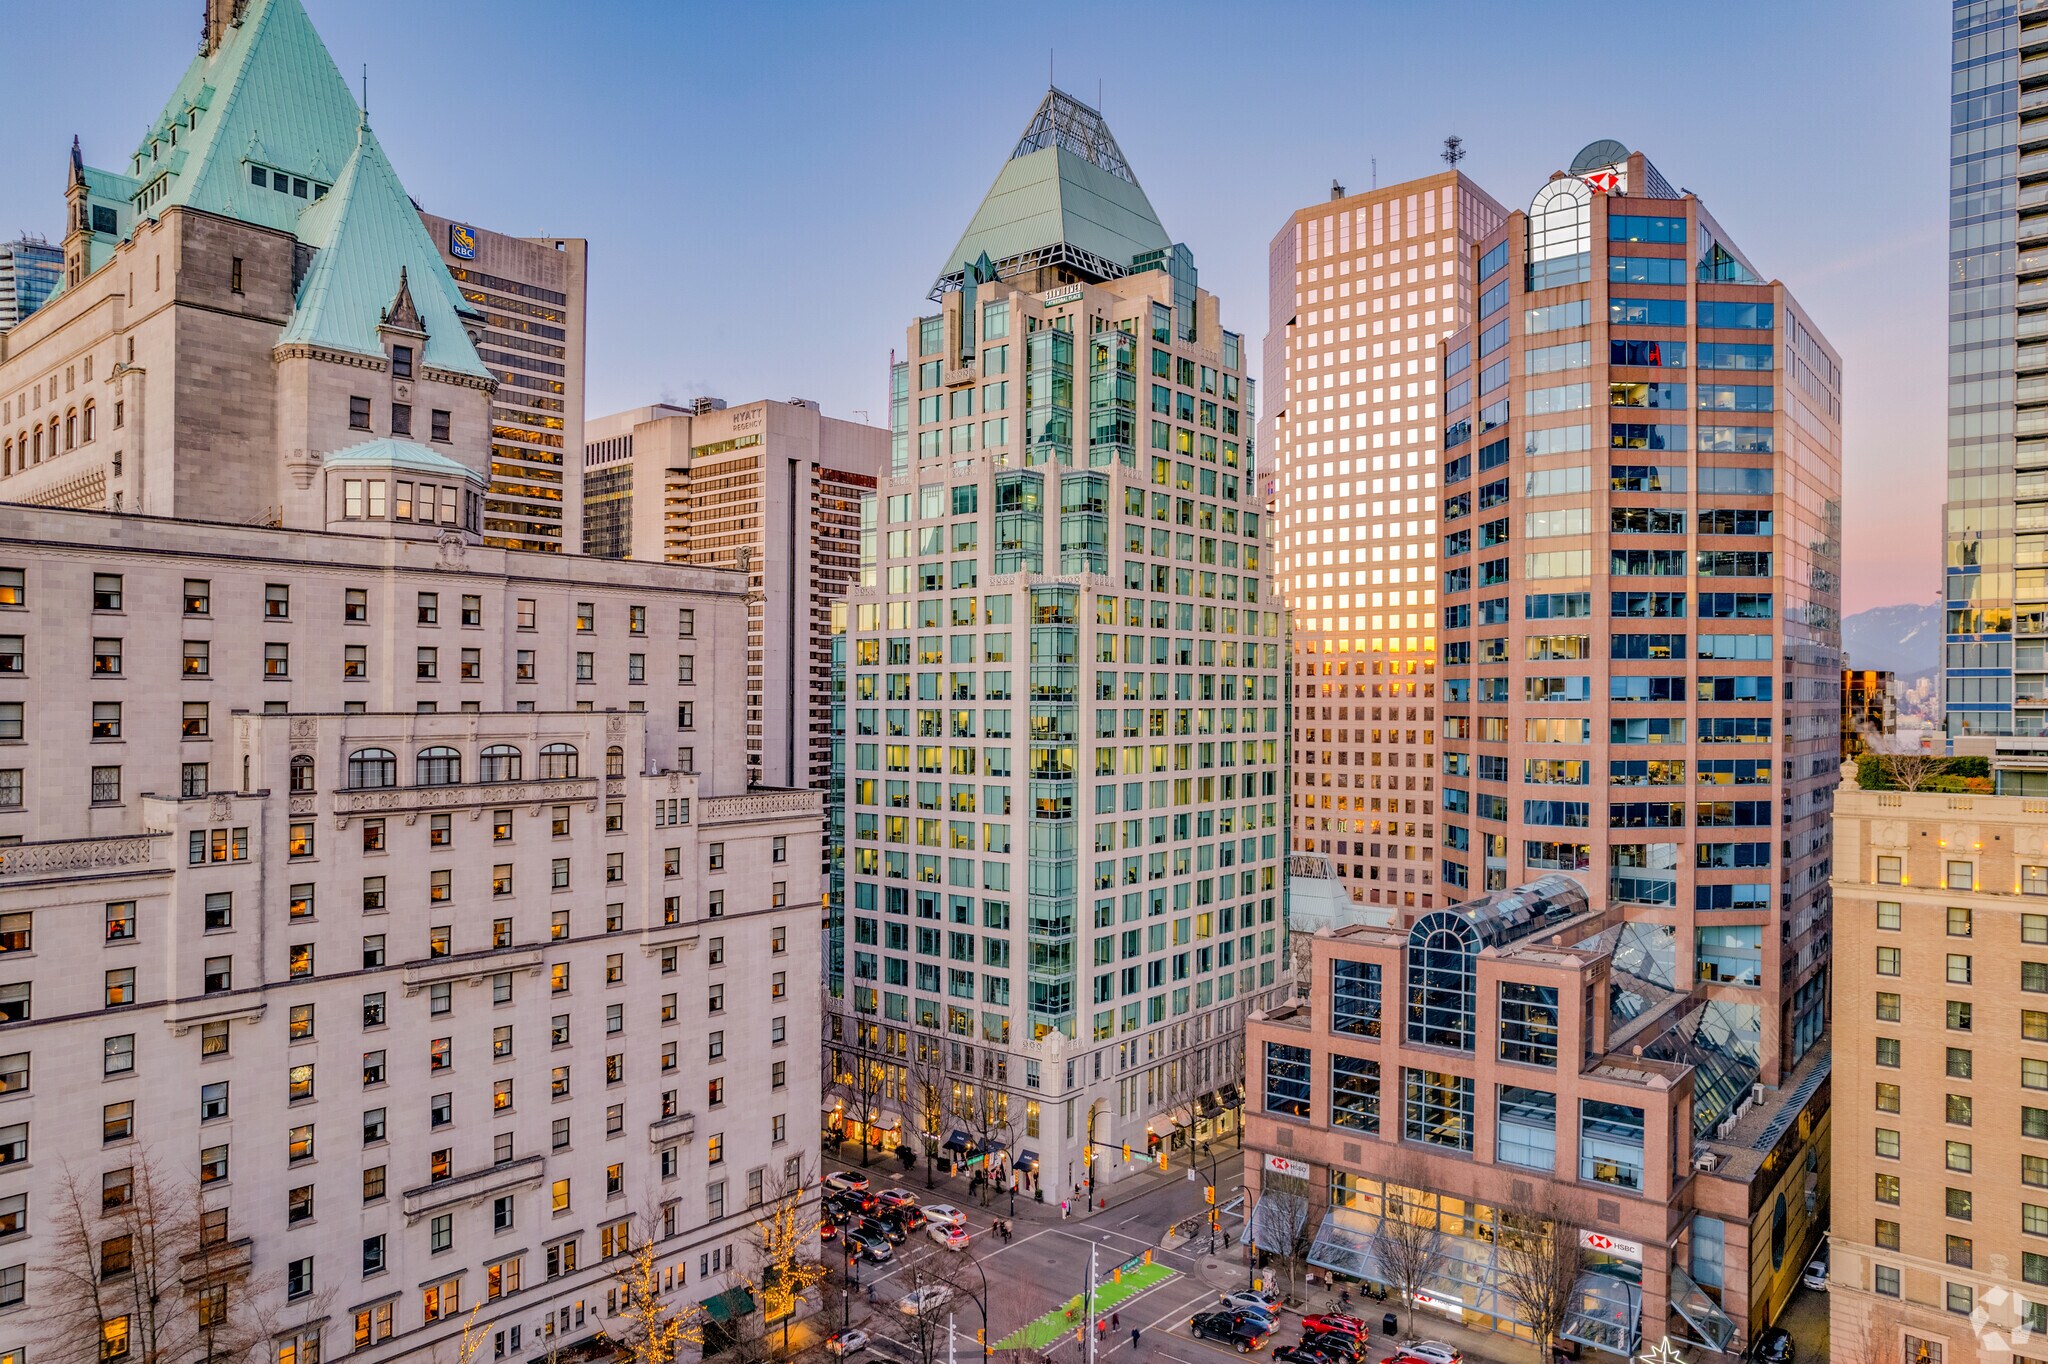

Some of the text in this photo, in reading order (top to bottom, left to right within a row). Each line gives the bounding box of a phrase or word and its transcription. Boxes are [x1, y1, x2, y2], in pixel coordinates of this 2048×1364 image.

[454, 245, 473, 257] RBC
[1068, 293, 1081, 302] PLACE
[733, 407, 763, 424] HYATT
[732, 419, 762, 432] REGENCY
[1290, 1164, 1306, 1173] HSBC
[1613, 1243, 1635, 1253] HSBC
